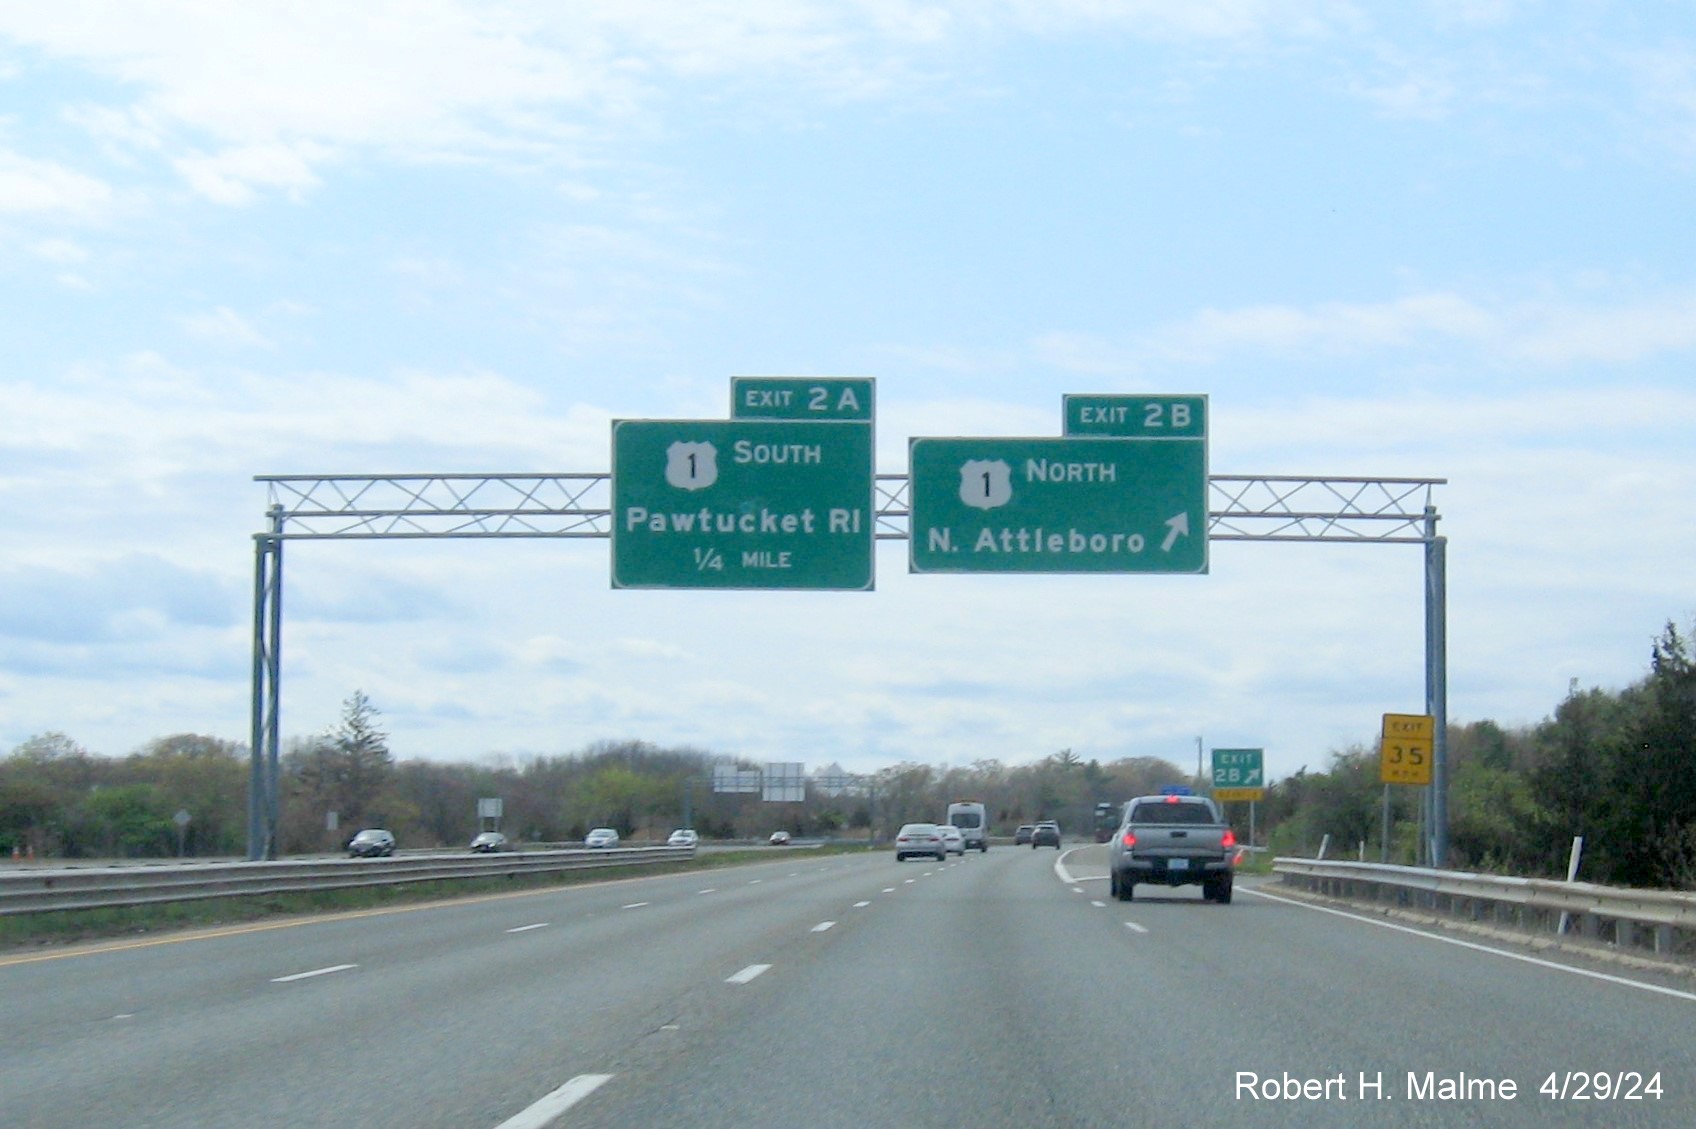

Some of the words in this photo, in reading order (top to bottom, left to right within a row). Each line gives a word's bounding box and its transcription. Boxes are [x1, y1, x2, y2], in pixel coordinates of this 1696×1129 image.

[746, 391, 793, 407] EXIT
[1080, 407, 1128, 423] EXIT
[734, 440, 821, 464] SOUTH
[687, 452, 696, 479] 1
[1027, 458, 1116, 482] NORTH
[981, 472, 990, 497] 1
[626, 507, 815, 533] Pawtucket
[829, 508, 860, 534] RI
[928, 527, 958, 552] N.
[975, 527, 1145, 552] Attleboro
[742, 552, 792, 568] MILE
[1221, 754, 1252, 765] EXIT
[1389, 746, 1423, 766] 35
[1215, 768, 1240, 782] 2B
